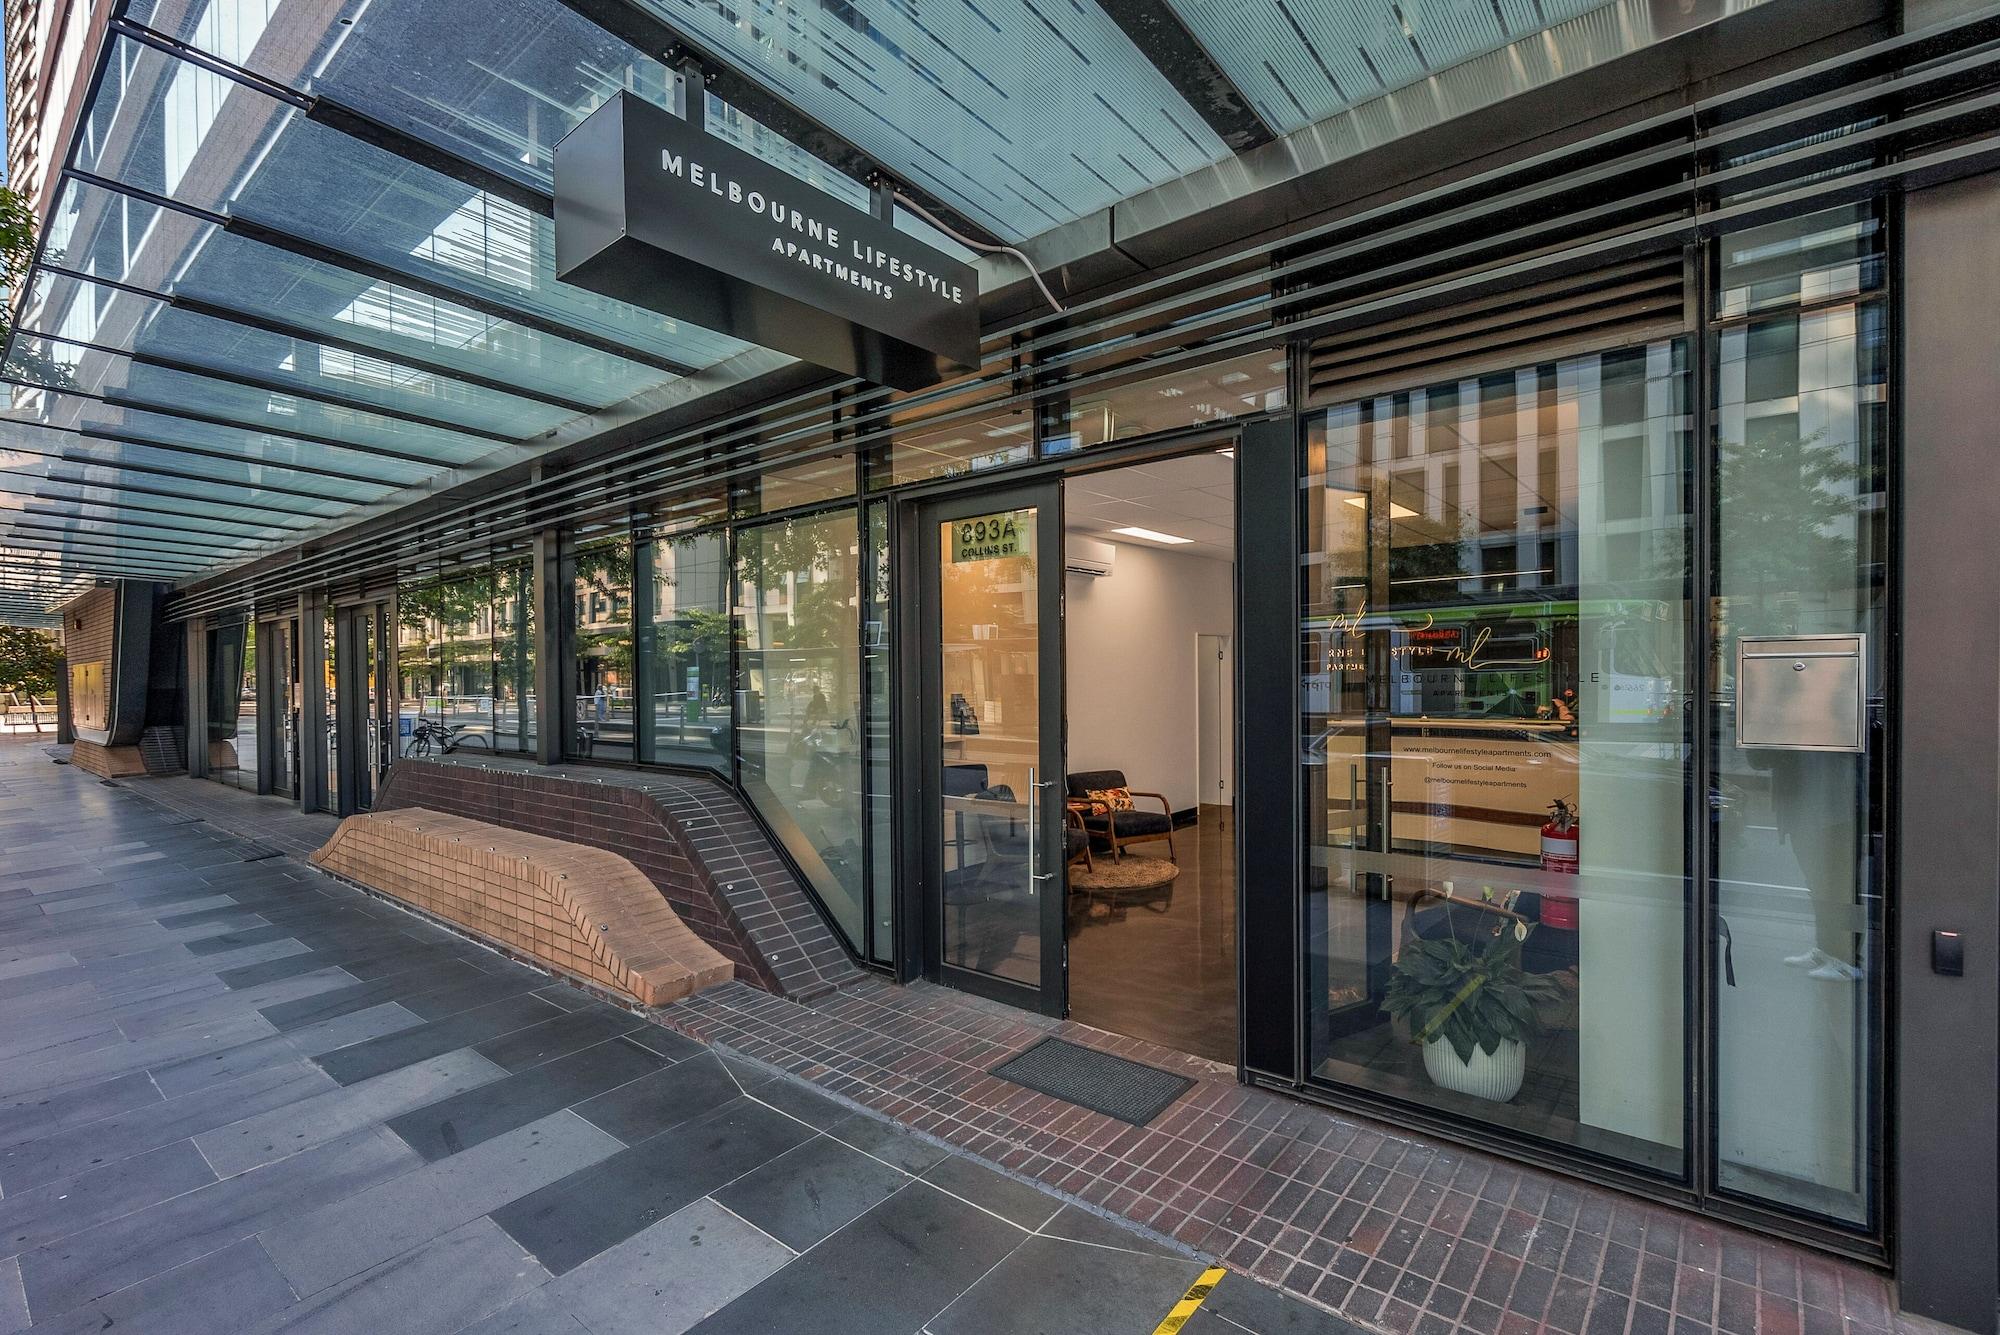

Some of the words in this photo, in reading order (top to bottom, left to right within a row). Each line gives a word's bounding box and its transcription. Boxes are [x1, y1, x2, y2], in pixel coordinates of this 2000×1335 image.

[660, 148, 840, 249] MELBOURNE
[853, 239, 963, 305] LIFESTYLE
[771, 237, 895, 301] APARTMENTS
[961, 518, 1017, 543] 893A
[961, 544, 1000, 558] COLLINS
[1002, 542, 1017, 554] ST.
[1403, 746, 1552, 758] www.melbournelifestyleapartments.com
[1432, 761, 1453, 770] Follow
[1424, 776, 1528, 789] @melbournelifestyleapartments
